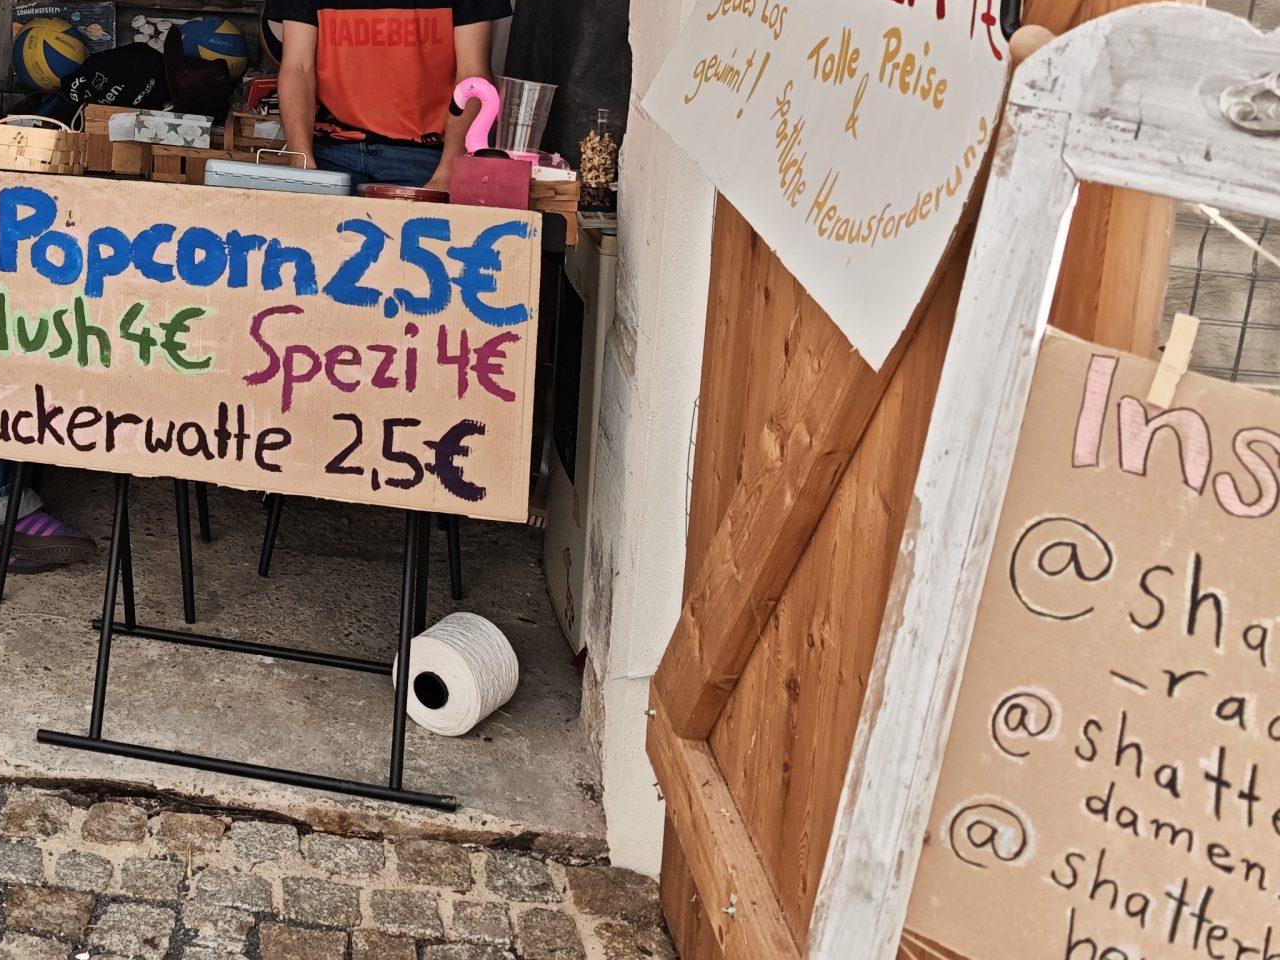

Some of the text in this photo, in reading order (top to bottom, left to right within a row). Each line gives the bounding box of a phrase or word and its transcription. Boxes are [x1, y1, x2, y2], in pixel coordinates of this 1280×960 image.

[807, 26, 948, 110] Tolle Preise
[805, 116, 988, 248] Herausforderung
[324, 214, 535, 328] 2,5€
[118, 301, 215, 375] 4€
[243, 304, 522, 413] Spezi 4€
[324, 413, 488, 503] 2,5€
